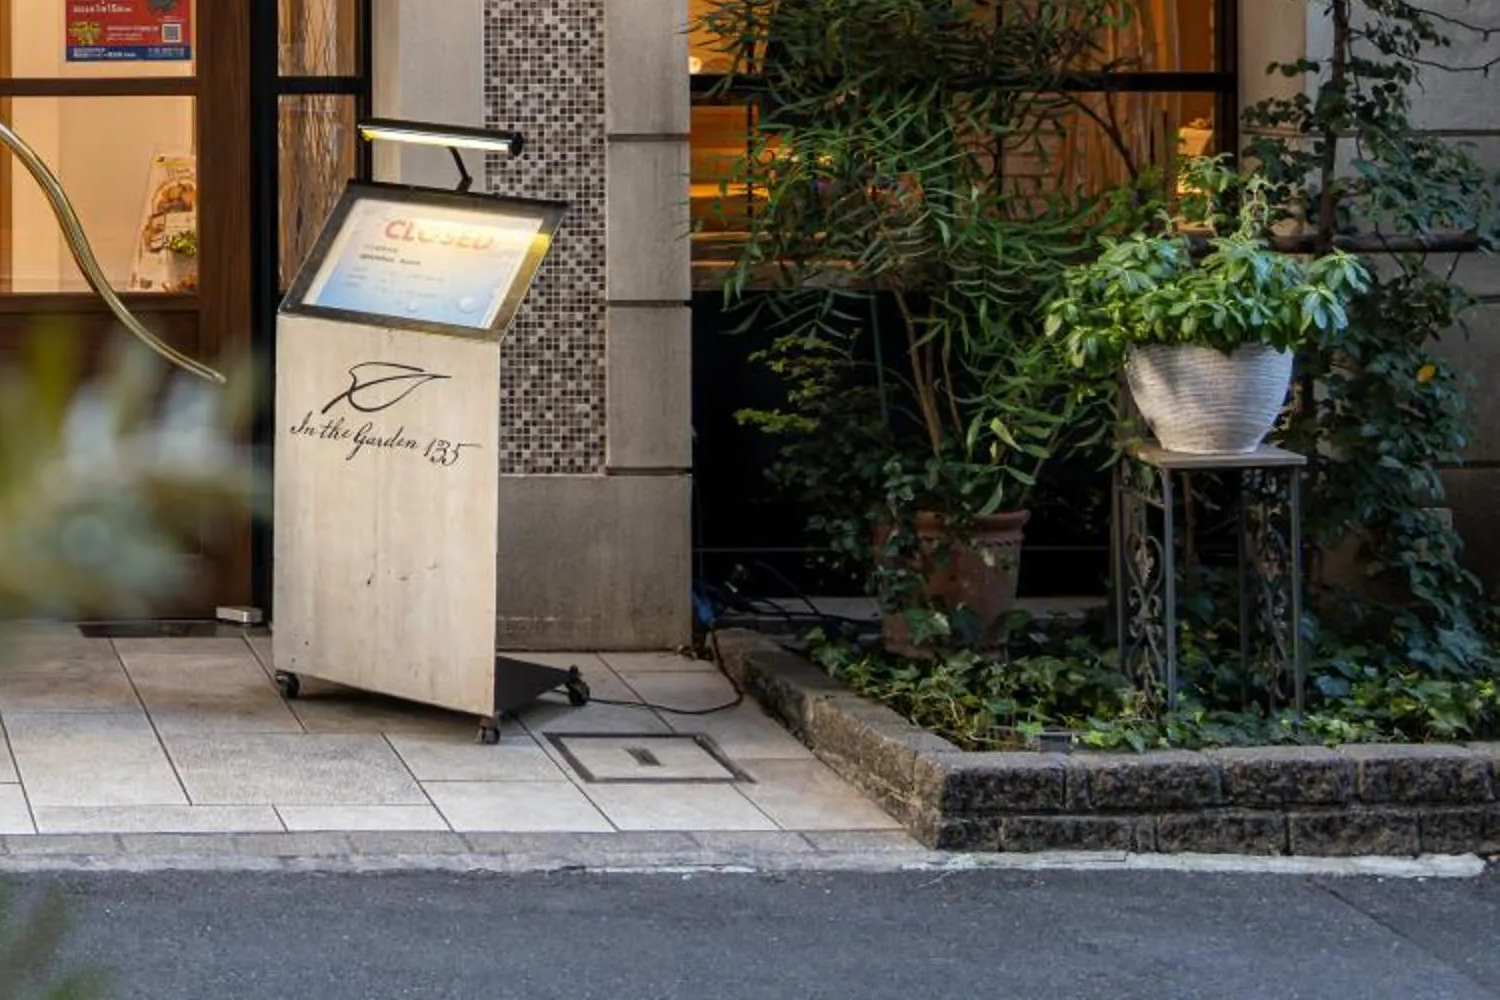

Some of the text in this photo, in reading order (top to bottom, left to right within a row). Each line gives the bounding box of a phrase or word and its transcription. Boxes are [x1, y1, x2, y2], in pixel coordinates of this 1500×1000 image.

[289, 410, 485, 466] In the Garden 135
